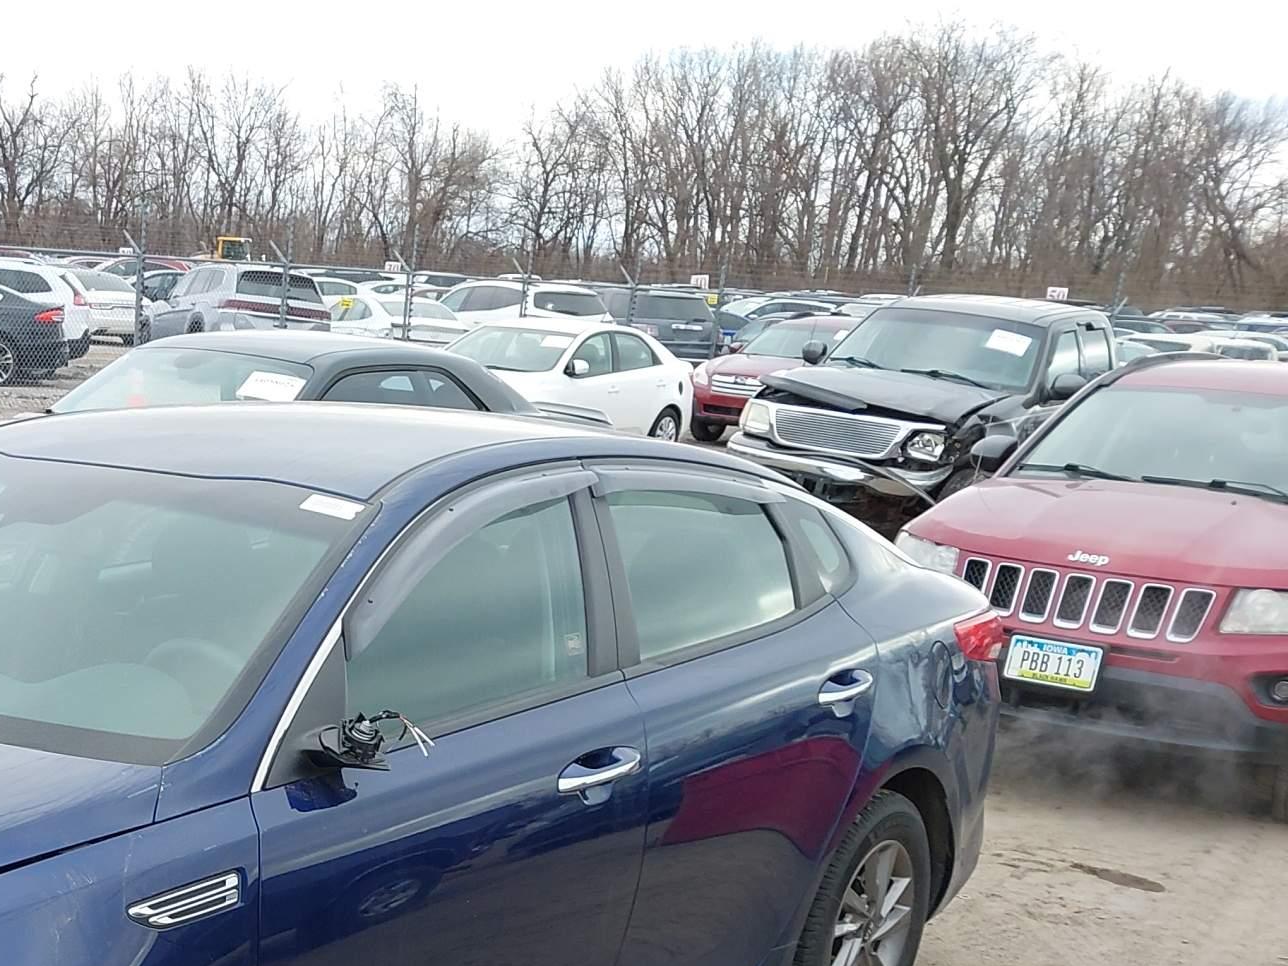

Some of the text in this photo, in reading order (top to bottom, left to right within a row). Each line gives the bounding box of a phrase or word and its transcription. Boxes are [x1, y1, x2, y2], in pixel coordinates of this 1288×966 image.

[1067, 550, 1109, 566] Jeep
[1043, 644, 1068, 655] IOWA
[1020, 650, 1084, 679] PBB 113
